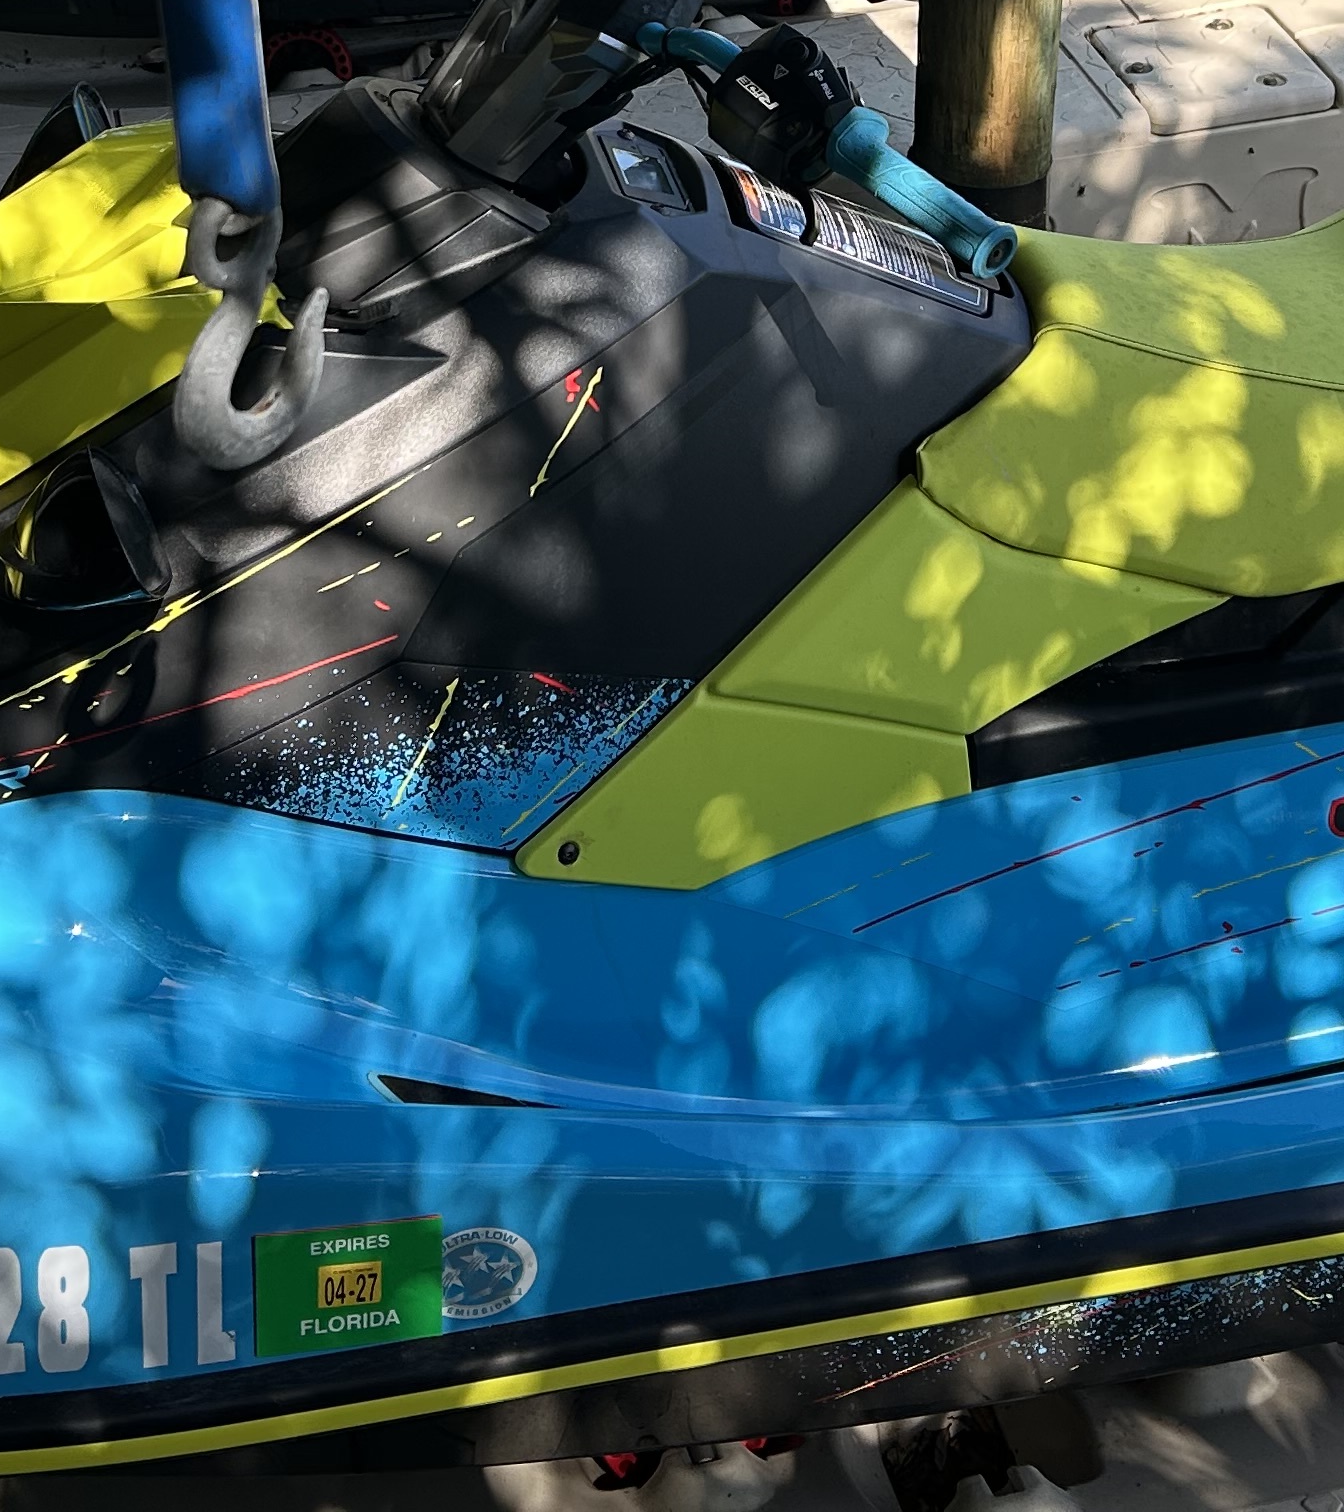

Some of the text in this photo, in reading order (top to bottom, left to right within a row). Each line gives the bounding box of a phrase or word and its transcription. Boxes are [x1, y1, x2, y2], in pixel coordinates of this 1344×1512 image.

[735, 74, 780, 111] RIDE
[309, 1233, 391, 1256] EXPIRES
[128, 1240, 238, 1369] TL
[324, 1272, 379, 1307] 04-27
[299, 1308, 401, 1336] FLORIDA
[446, 1297, 512, 1317] EMISSION
